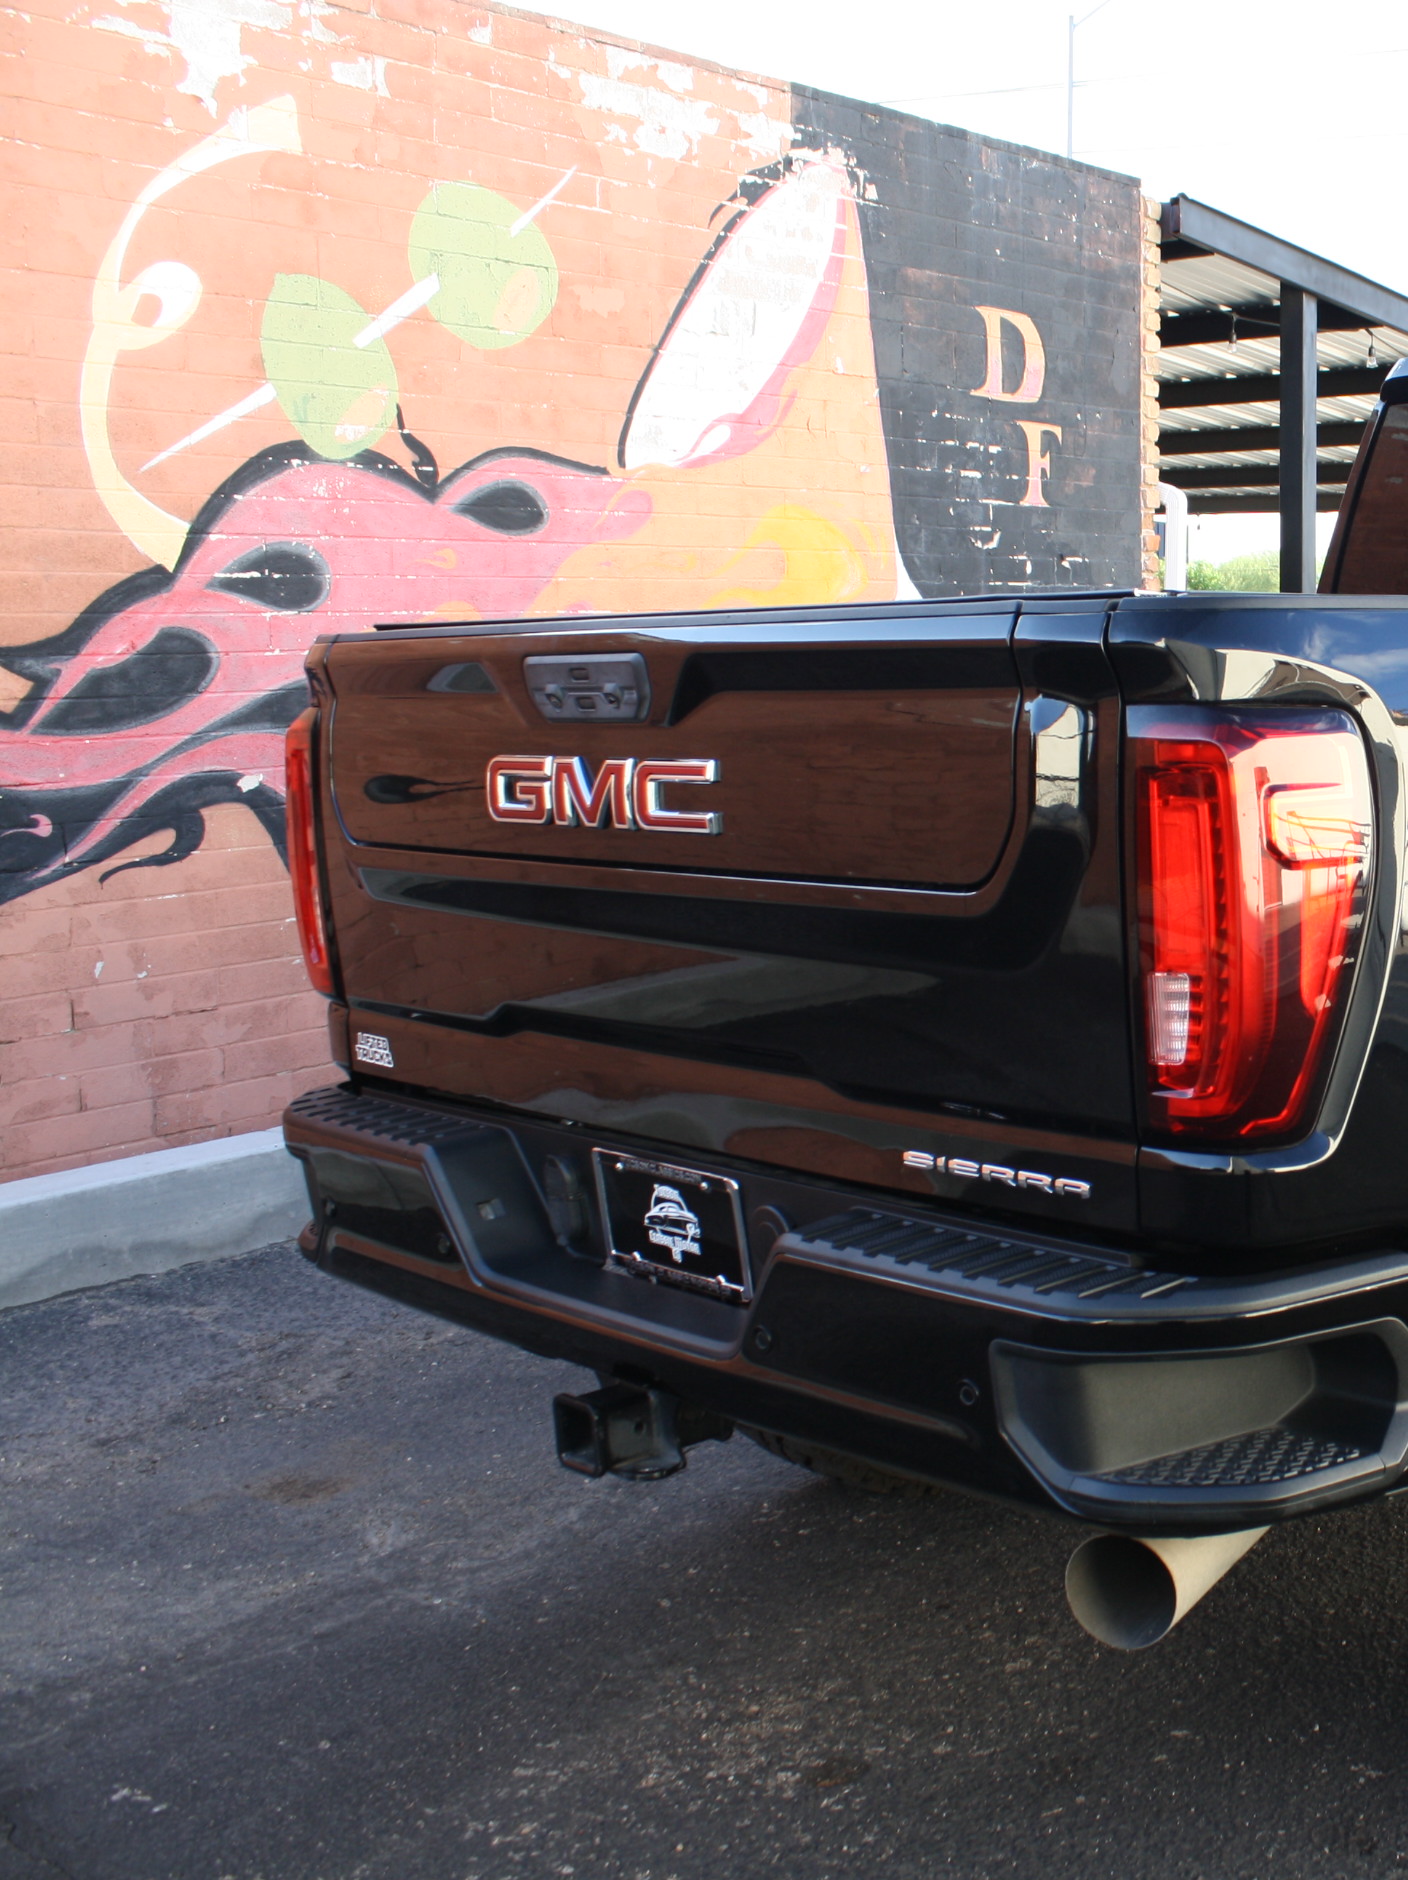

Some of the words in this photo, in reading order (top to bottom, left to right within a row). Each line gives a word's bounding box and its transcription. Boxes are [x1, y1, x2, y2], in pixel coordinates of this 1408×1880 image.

[970, 306, 1046, 403] D
[1015, 421, 1062, 507] F
[486, 755, 723, 834] GMC
[902, 1149, 1093, 1199] SIERRA
